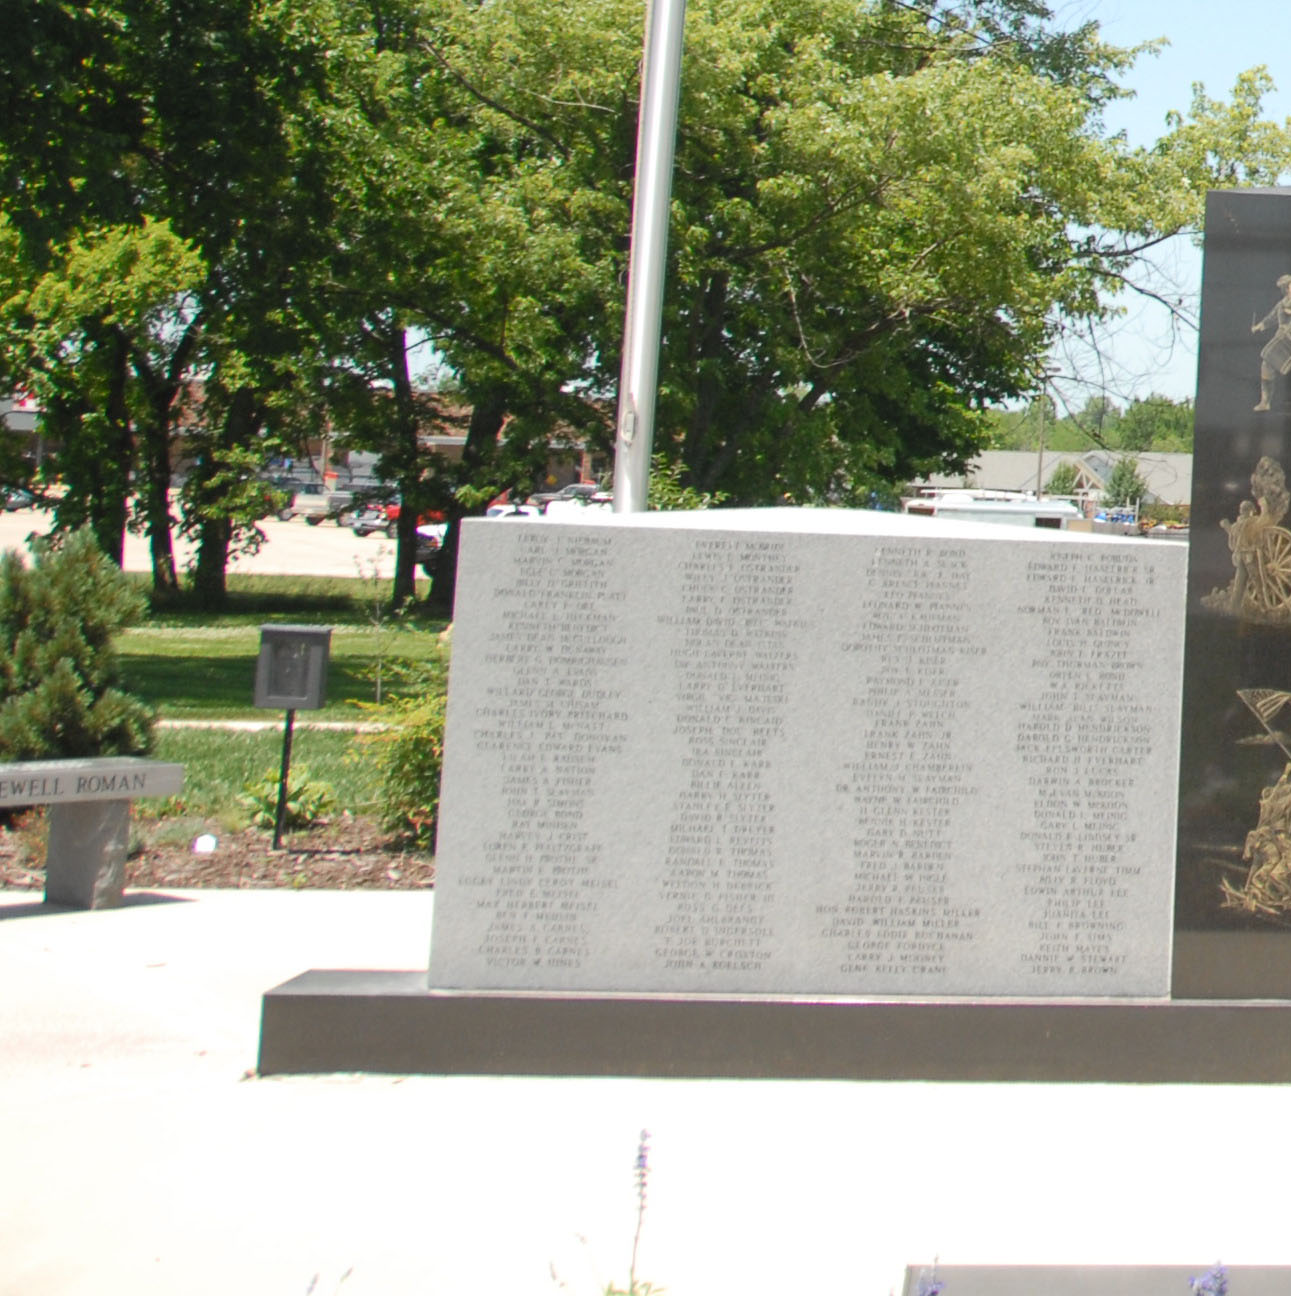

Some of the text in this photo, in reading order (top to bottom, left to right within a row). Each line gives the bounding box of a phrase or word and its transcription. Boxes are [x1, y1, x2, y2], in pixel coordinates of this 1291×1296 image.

[476, 708, 522, 718] CHARLES
[568, 710, 628, 720] PRITCHARD
[76, 774, 147, 794] ROMAN
[943, 907, 980, 917] MILLER
[922, 919, 959, 928] MILLER
[655, 947, 697, 957] GEORGE
